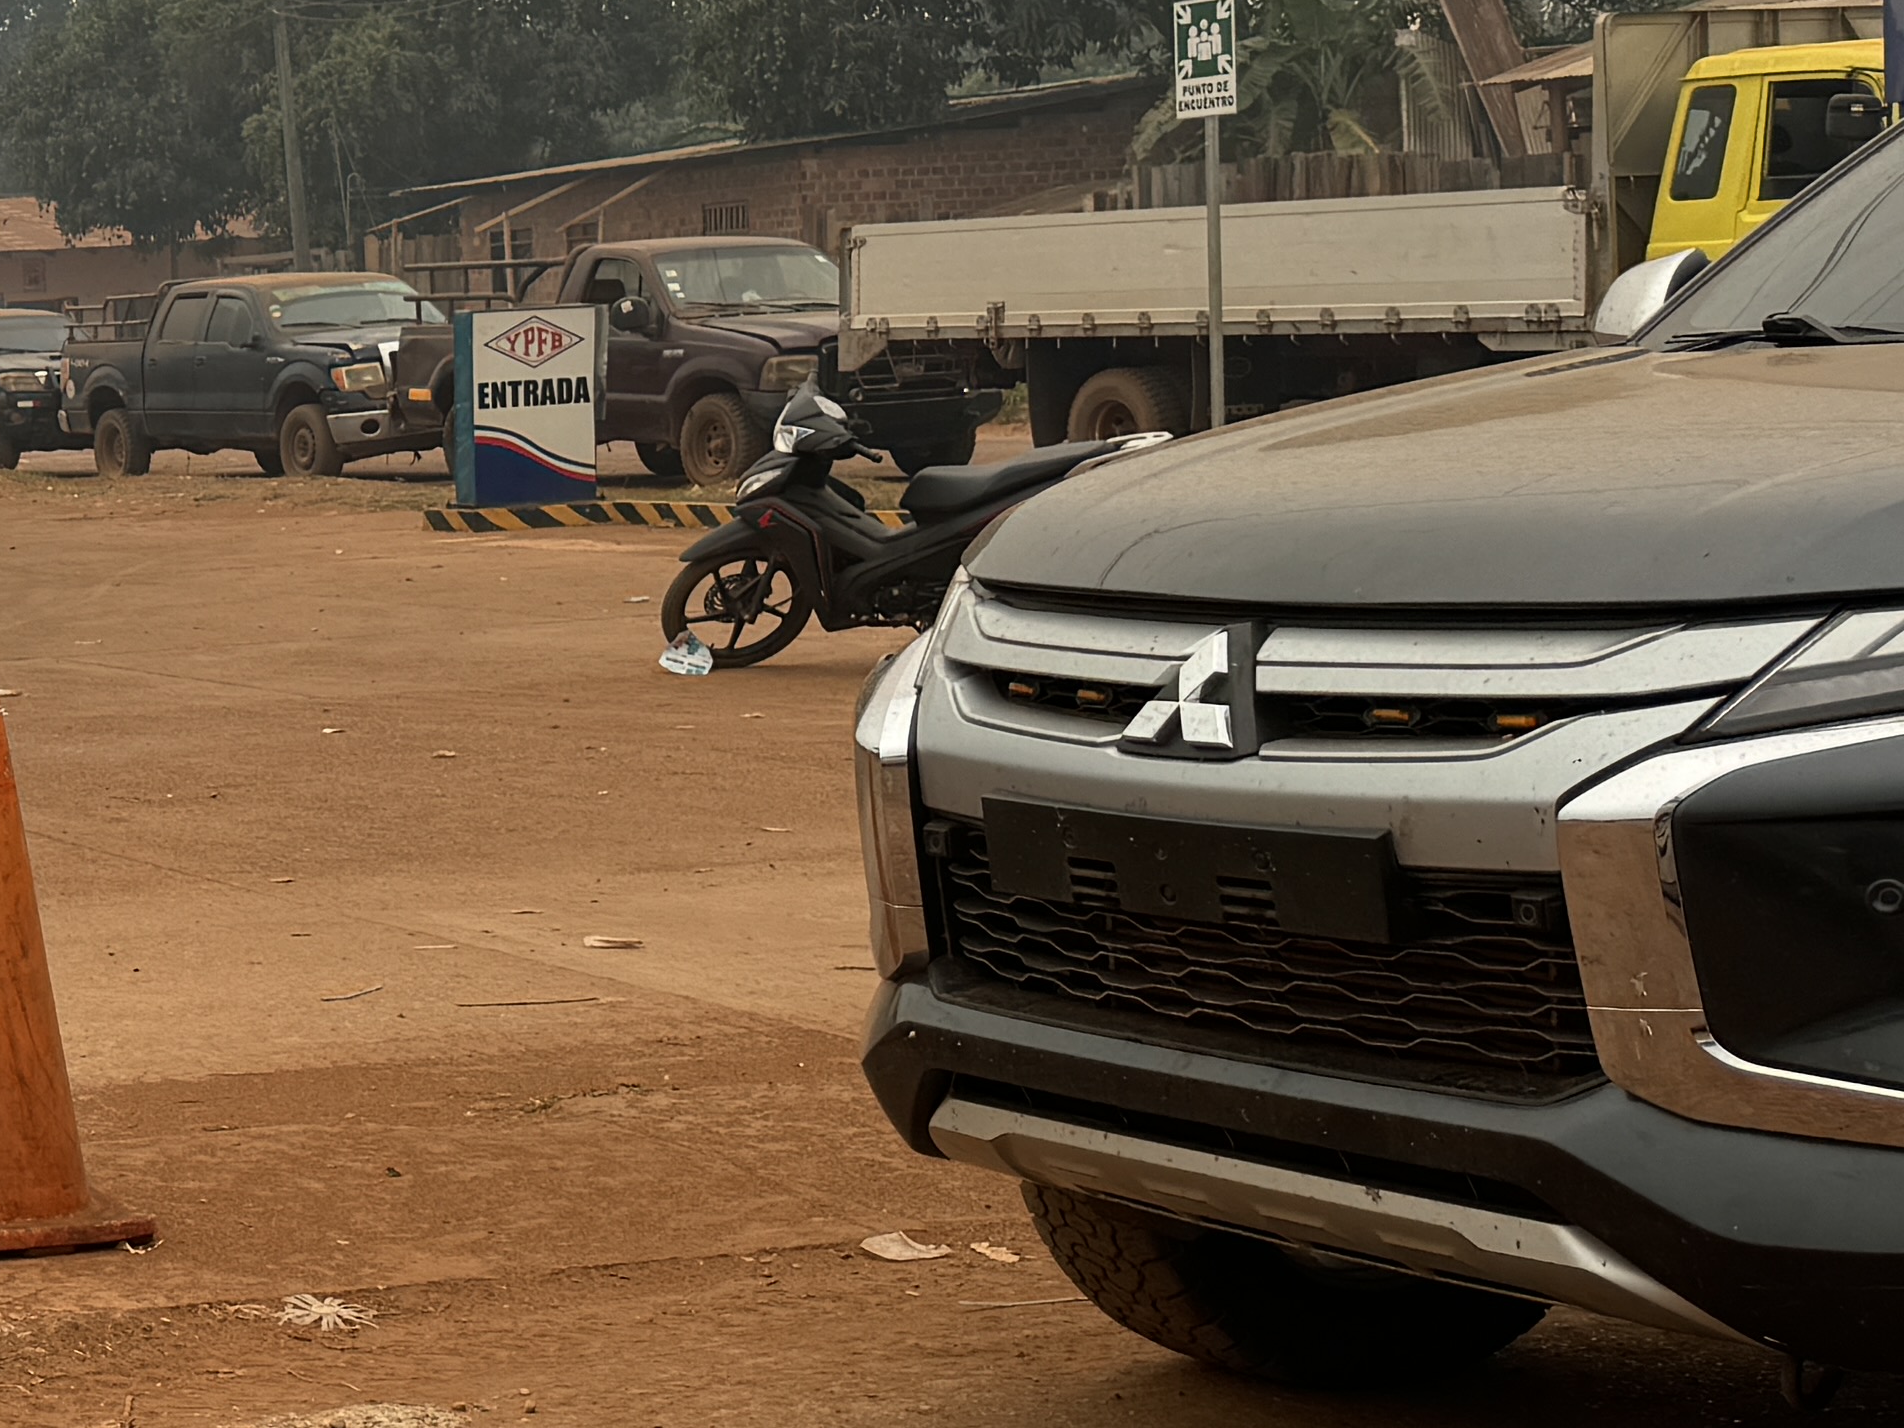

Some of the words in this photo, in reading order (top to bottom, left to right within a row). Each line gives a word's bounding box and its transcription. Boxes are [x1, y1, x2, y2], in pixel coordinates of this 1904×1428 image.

[1182, 82, 1213, 97] PUNTO
[1216, 80, 1229, 92] DE
[1178, 95, 1234, 112] ENCUENTRO
[506, 326, 563, 358] YPFB
[478, 376, 591, 410] ENTRADA
